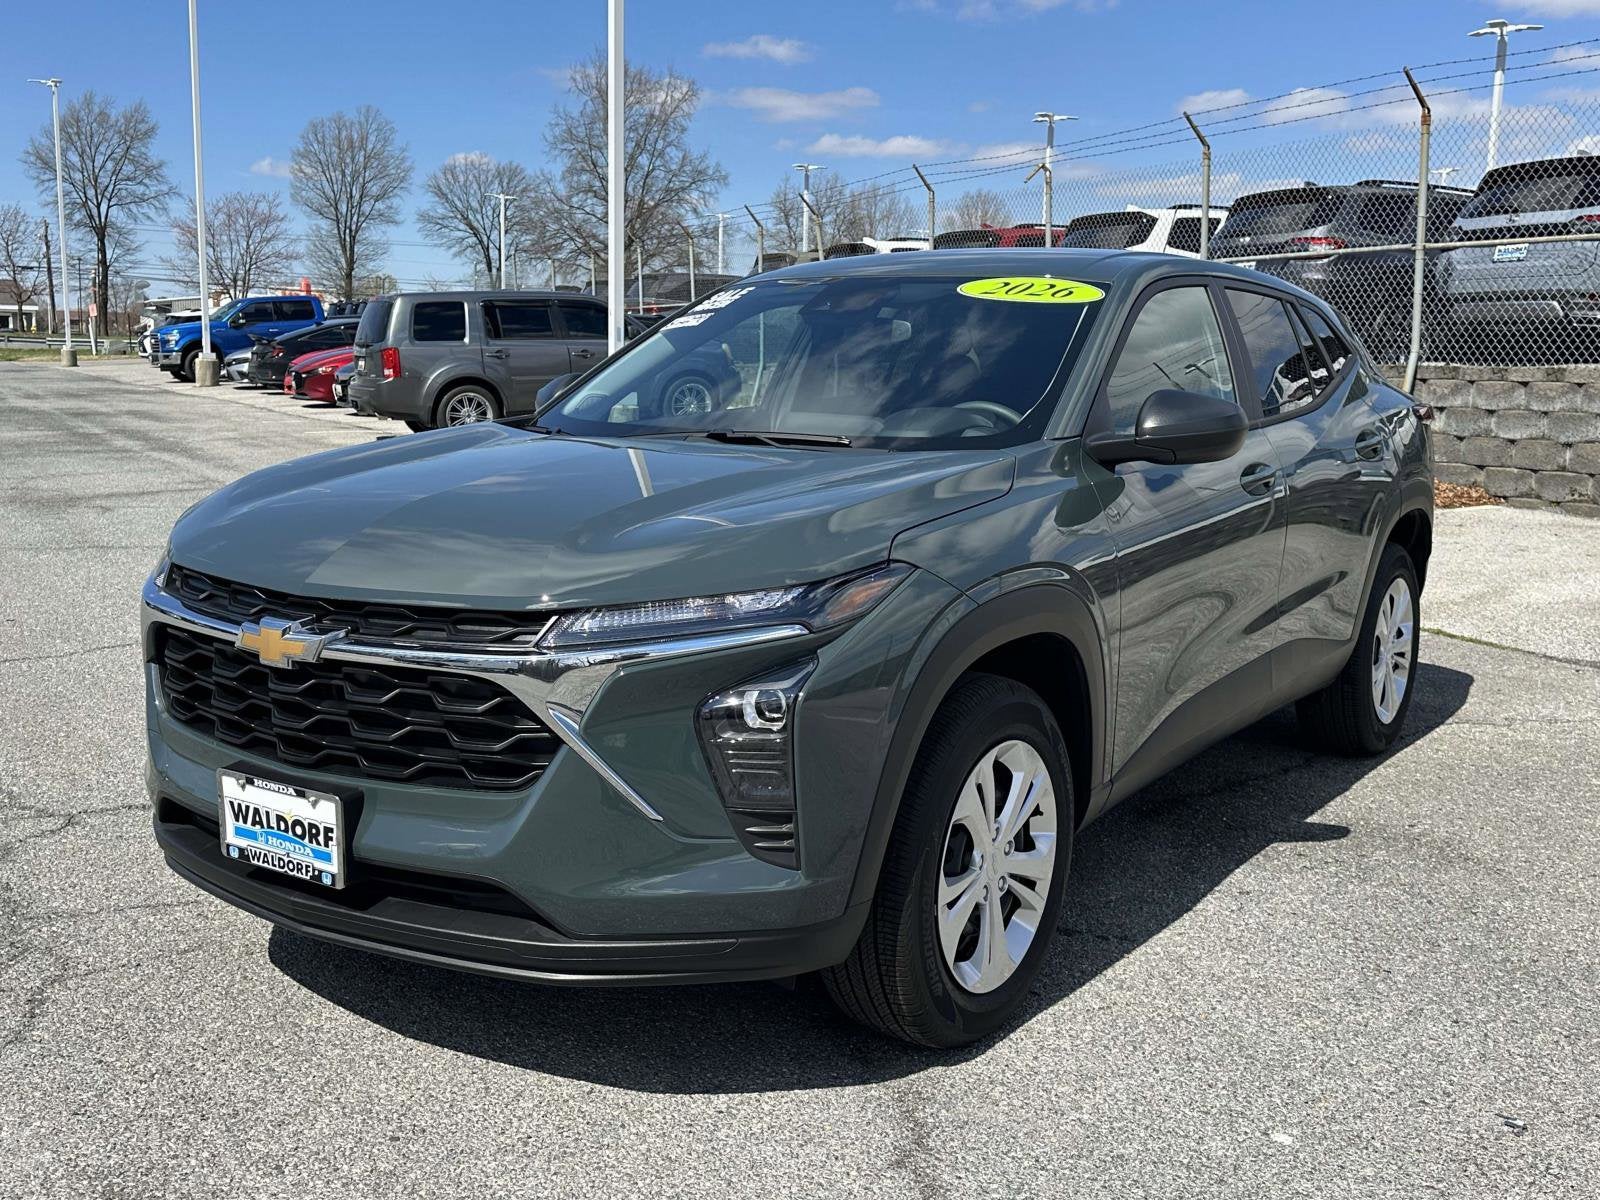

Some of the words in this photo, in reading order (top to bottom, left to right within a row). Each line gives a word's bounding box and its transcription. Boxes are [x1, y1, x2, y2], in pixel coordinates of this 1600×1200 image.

[979, 281, 1077, 298] 2026
[253, 778, 297, 796] HONDA
[229, 800, 334, 849] WALDORF
[267, 836, 314, 857] HONDA
[249, 848, 312, 877] WALDORF
